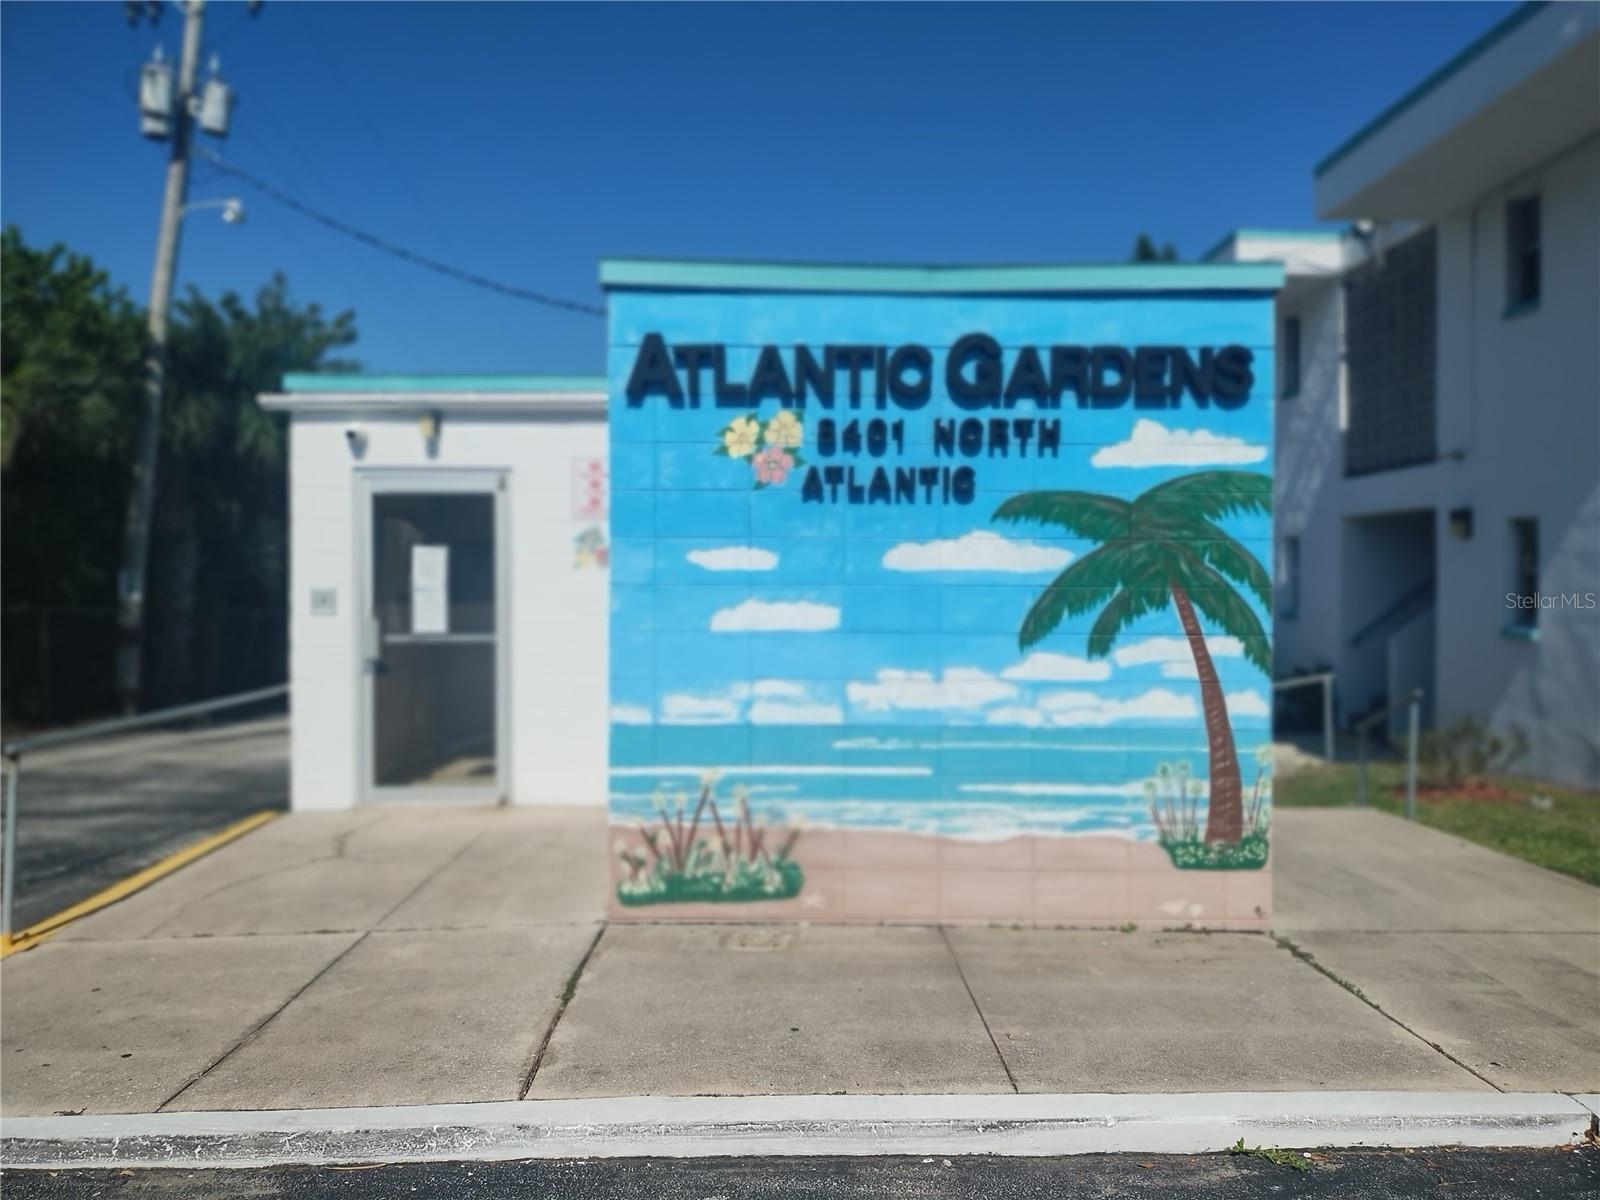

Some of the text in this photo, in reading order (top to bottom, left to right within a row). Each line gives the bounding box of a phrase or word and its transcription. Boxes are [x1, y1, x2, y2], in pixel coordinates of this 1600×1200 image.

[626, 332, 1255, 410] ATLANTIC GARDENS
[934, 418, 1061, 458] NORTH
[802, 466, 976, 505] ATLANTIC
